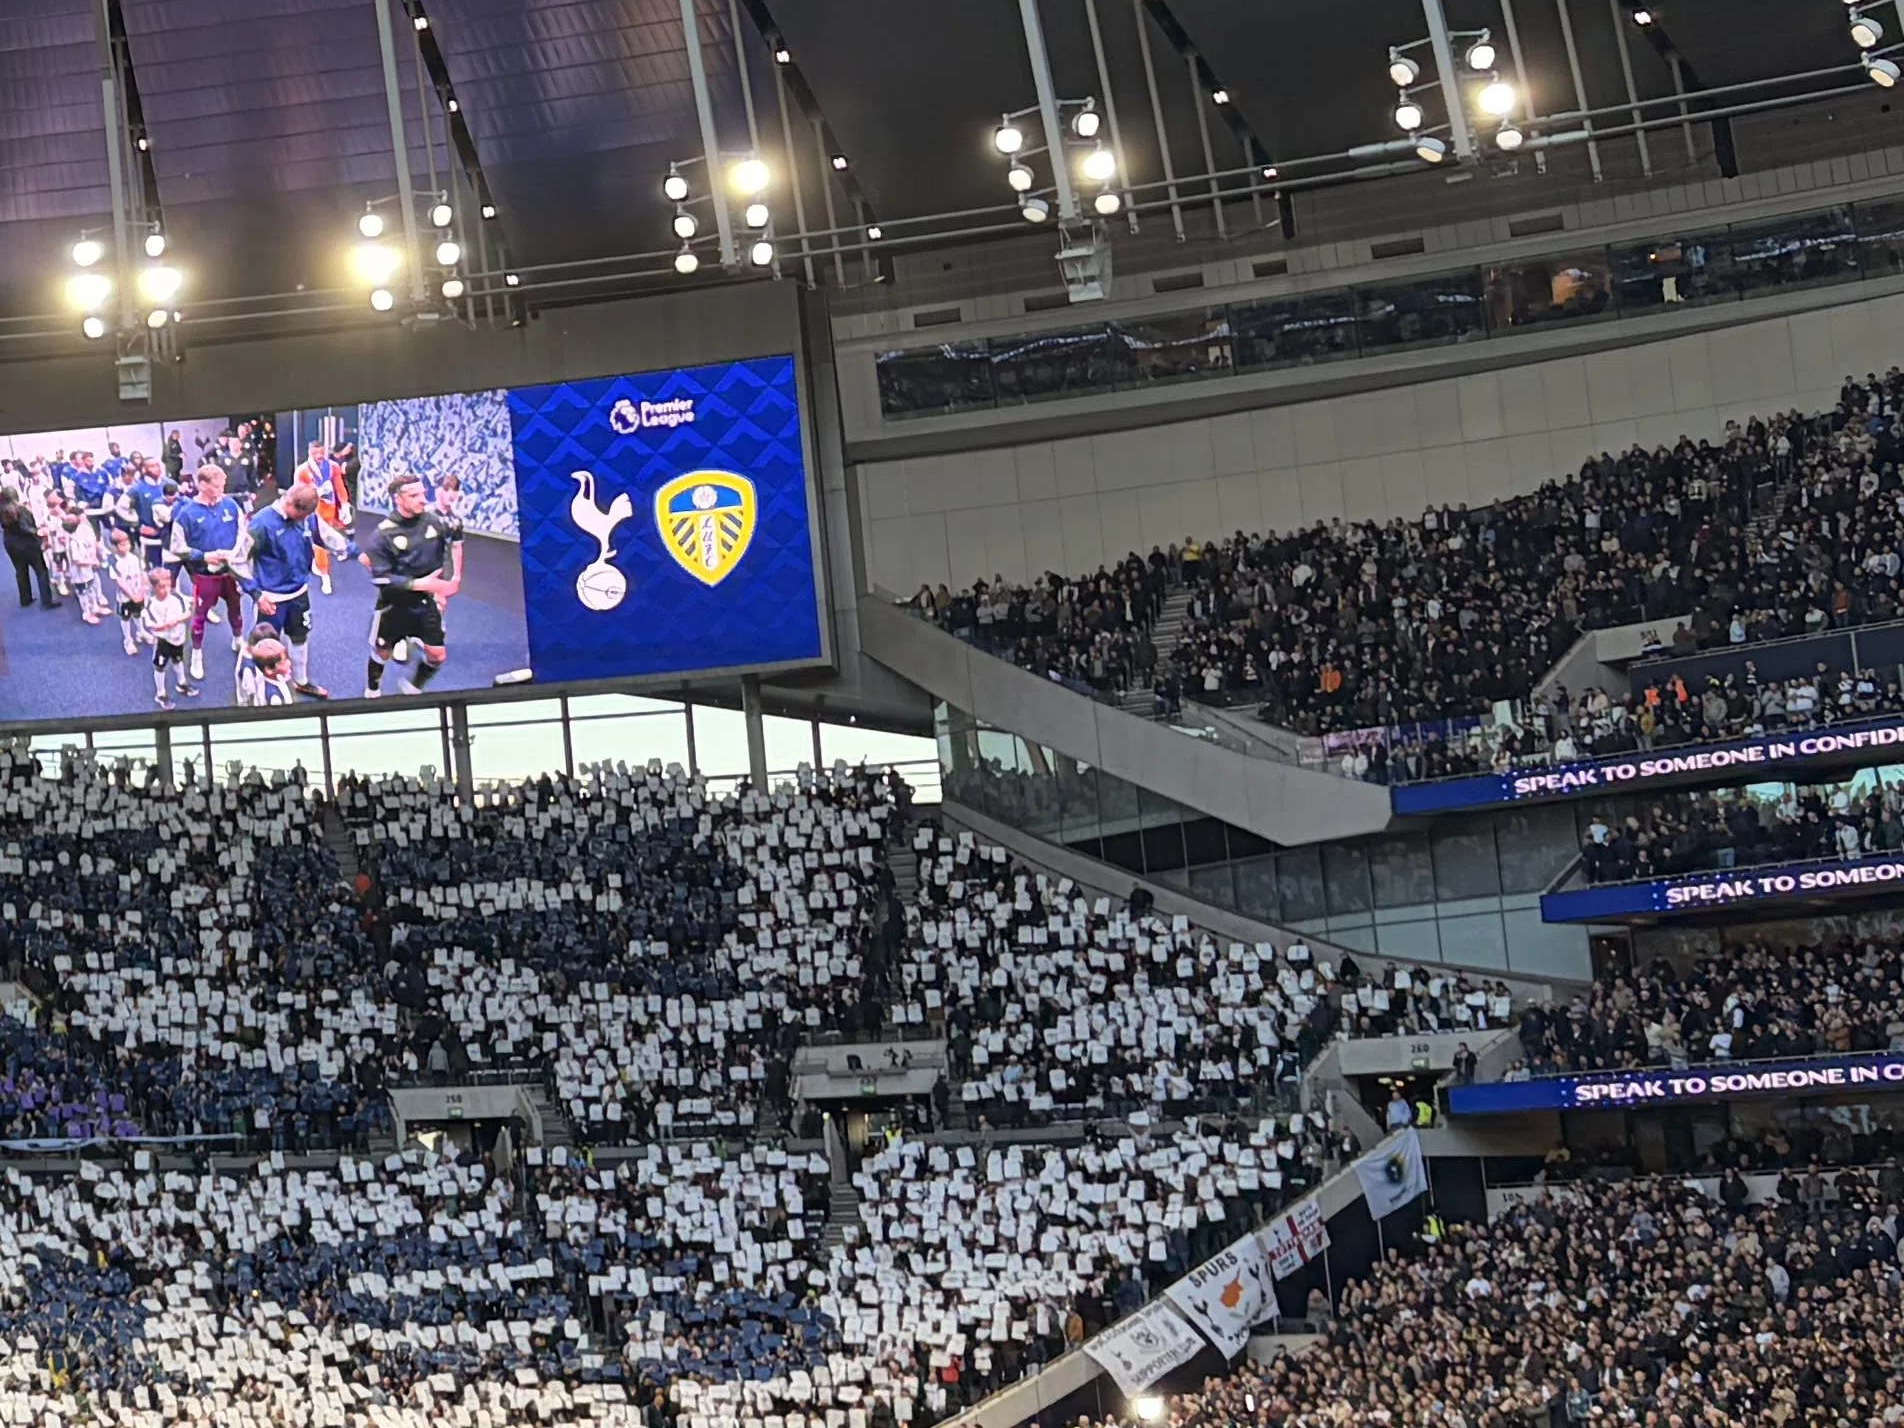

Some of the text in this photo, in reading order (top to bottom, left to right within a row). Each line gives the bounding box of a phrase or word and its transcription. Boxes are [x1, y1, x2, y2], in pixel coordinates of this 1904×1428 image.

[641, 398, 694, 414] Premier
[641, 411, 695, 428] League
[1515, 769, 1598, 794] SPEAK
[1601, 763, 1637, 781] TO
[1640, 748, 1766, 778] SOMEONE
[1769, 741, 1795, 759] IN
[1665, 879, 1755, 904] SPEAK
[1758, 876, 1796, 893] TO
[1575, 1079, 1665, 1102] SPEAK
[1669, 1076, 1707, 1094] TO
[1710, 1068, 1846, 1093] SOMEONE
[1850, 1065, 1879, 1082] IN
[1187, 1250, 1239, 1292] SPURS
